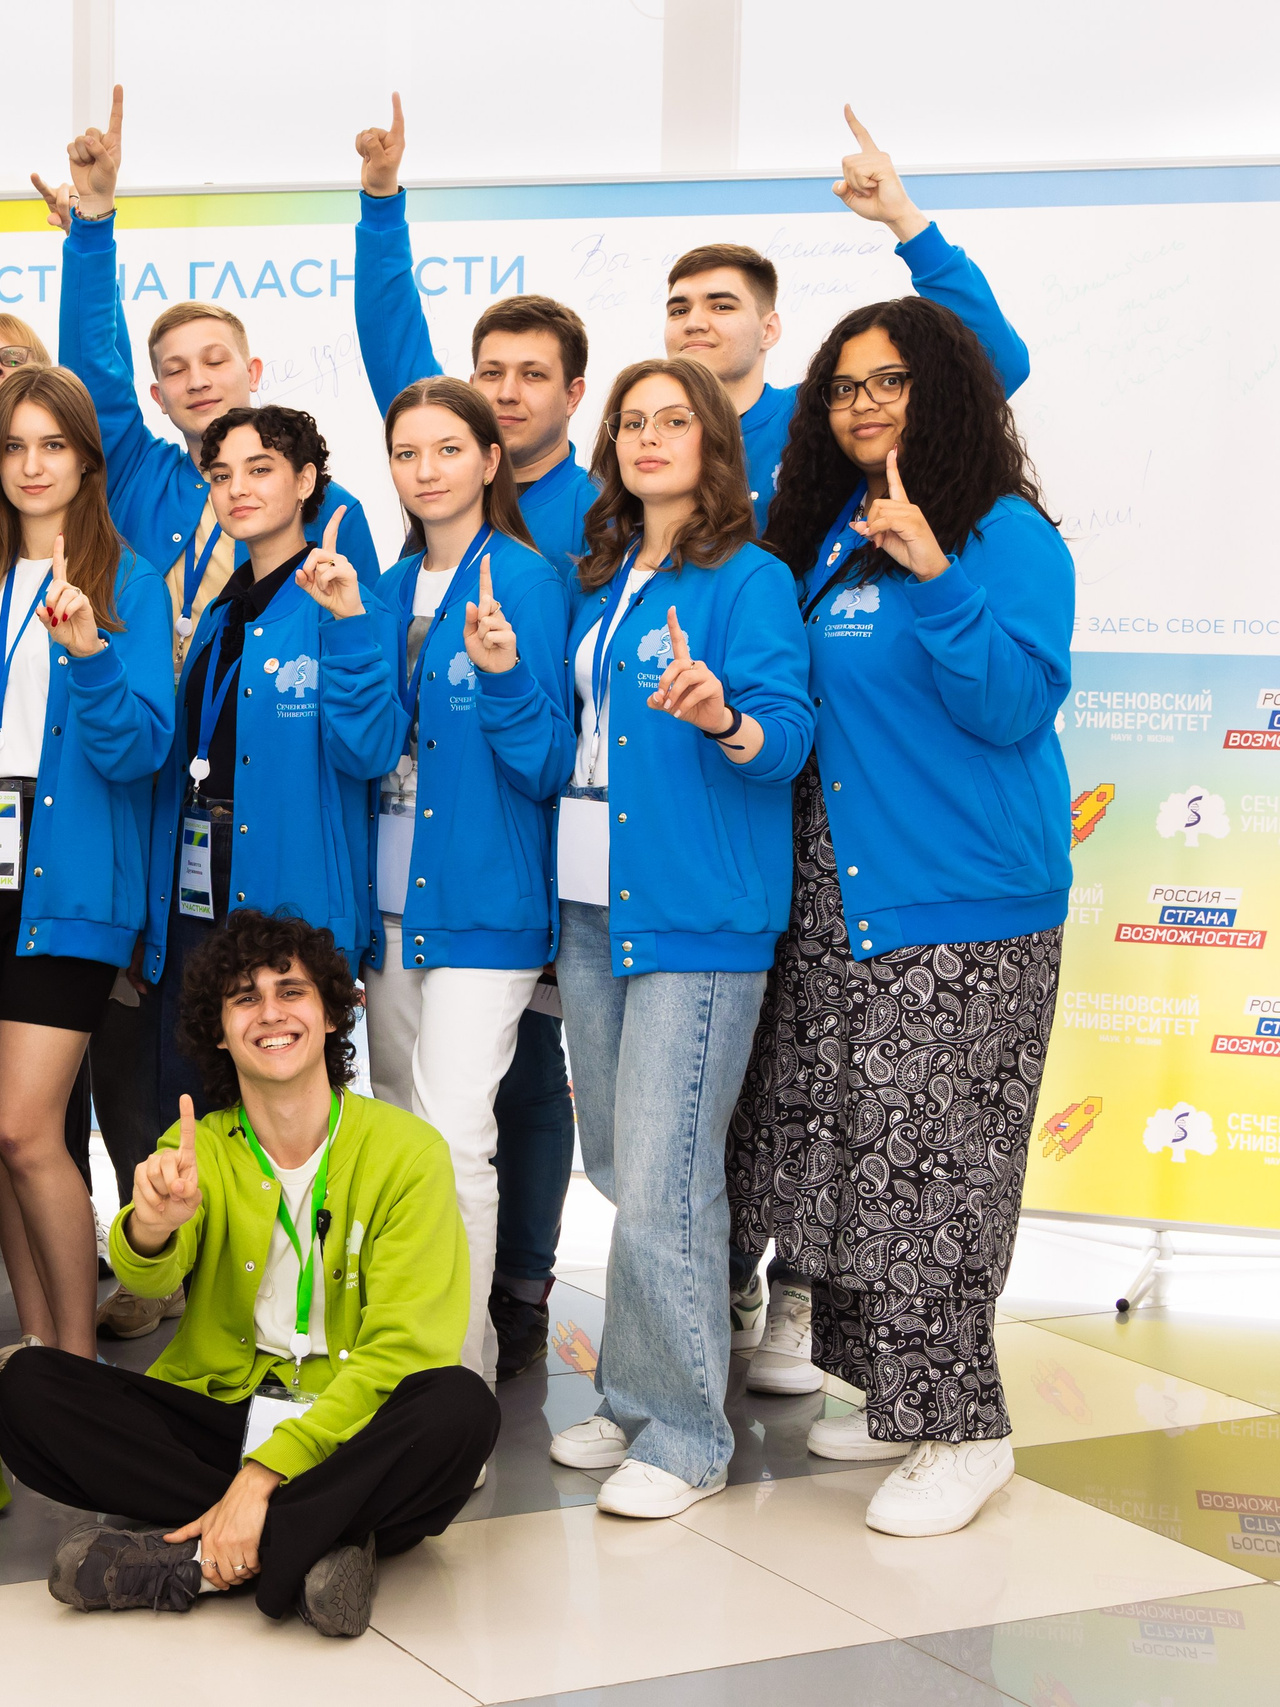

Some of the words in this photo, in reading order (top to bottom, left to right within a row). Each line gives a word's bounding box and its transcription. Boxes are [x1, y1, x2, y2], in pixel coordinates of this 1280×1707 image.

[189, 254, 525, 301] ГЛАСНСТИ
[1088, 617, 1159, 635] ЗДЕСЬ
[1166, 618, 1225, 634] СВОЕ
[1074, 689, 1213, 711] СЕЧЕНОВСКИЙ
[1074, 711, 1213, 732] УНИВЕРСИТЕТ
[1110, 733, 1132, 742] НАУК
[1137, 734, 1143, 742] О
[1147, 734, 1174, 744] ЖИЗНИ
[1153, 888, 1221, 904] РОССИЯ
[181, 902, 211, 914] УЧАСТНИК
[1163, 909, 1230, 926] СТРАНА
[1120, 927, 1262, 947] ВОЗМОЖНОСТЕЙ
[1063, 991, 1200, 1016] СЕЧЕНОВСКИЙ
[1063, 1011, 1200, 1035] УНИВЕРСИТЕТ
[1099, 1035, 1120, 1043] НАУК
[782, 1289, 810, 1303] adidas
